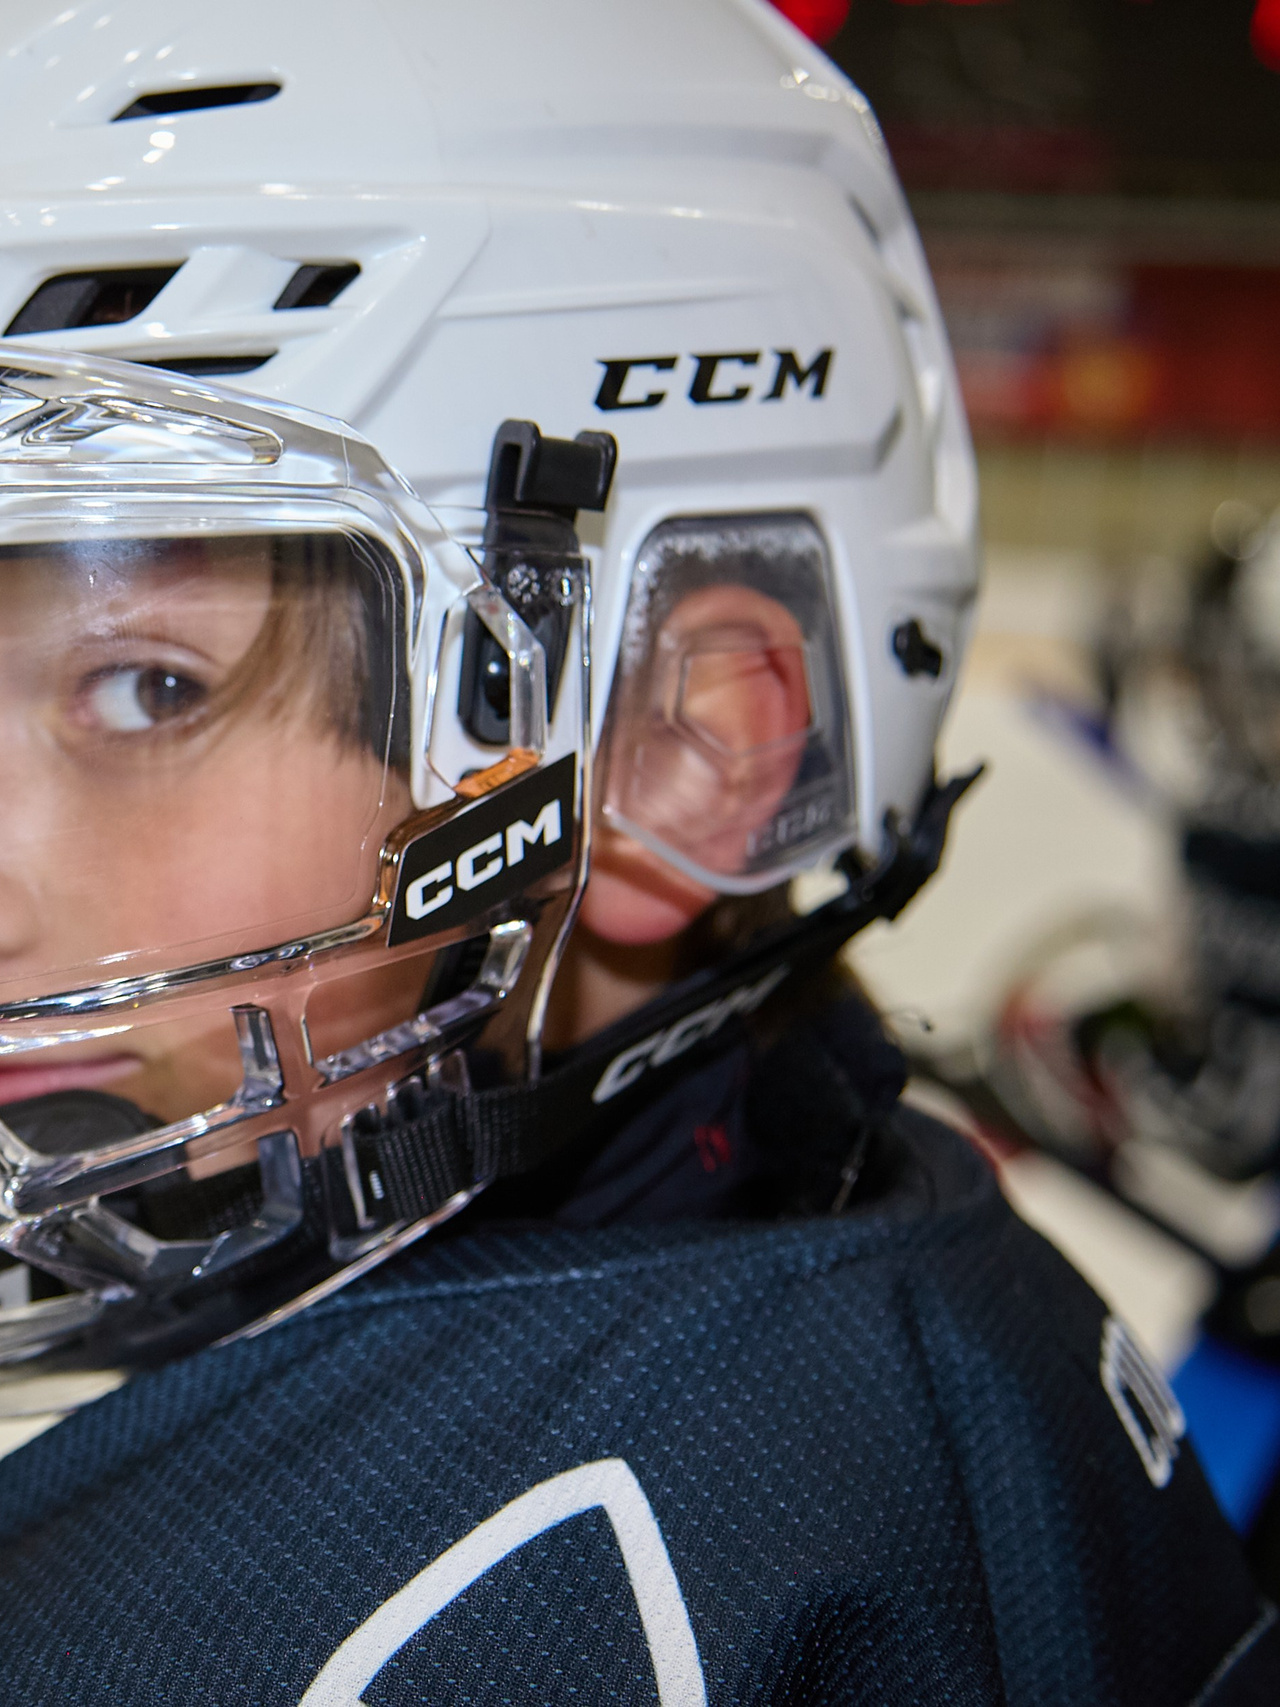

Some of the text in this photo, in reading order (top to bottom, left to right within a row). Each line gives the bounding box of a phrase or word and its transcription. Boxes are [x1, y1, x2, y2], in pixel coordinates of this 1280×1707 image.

[593, 346, 836, 412] CCM
[405, 798, 563, 921] CCM
[592, 962, 792, 1104] CCM
